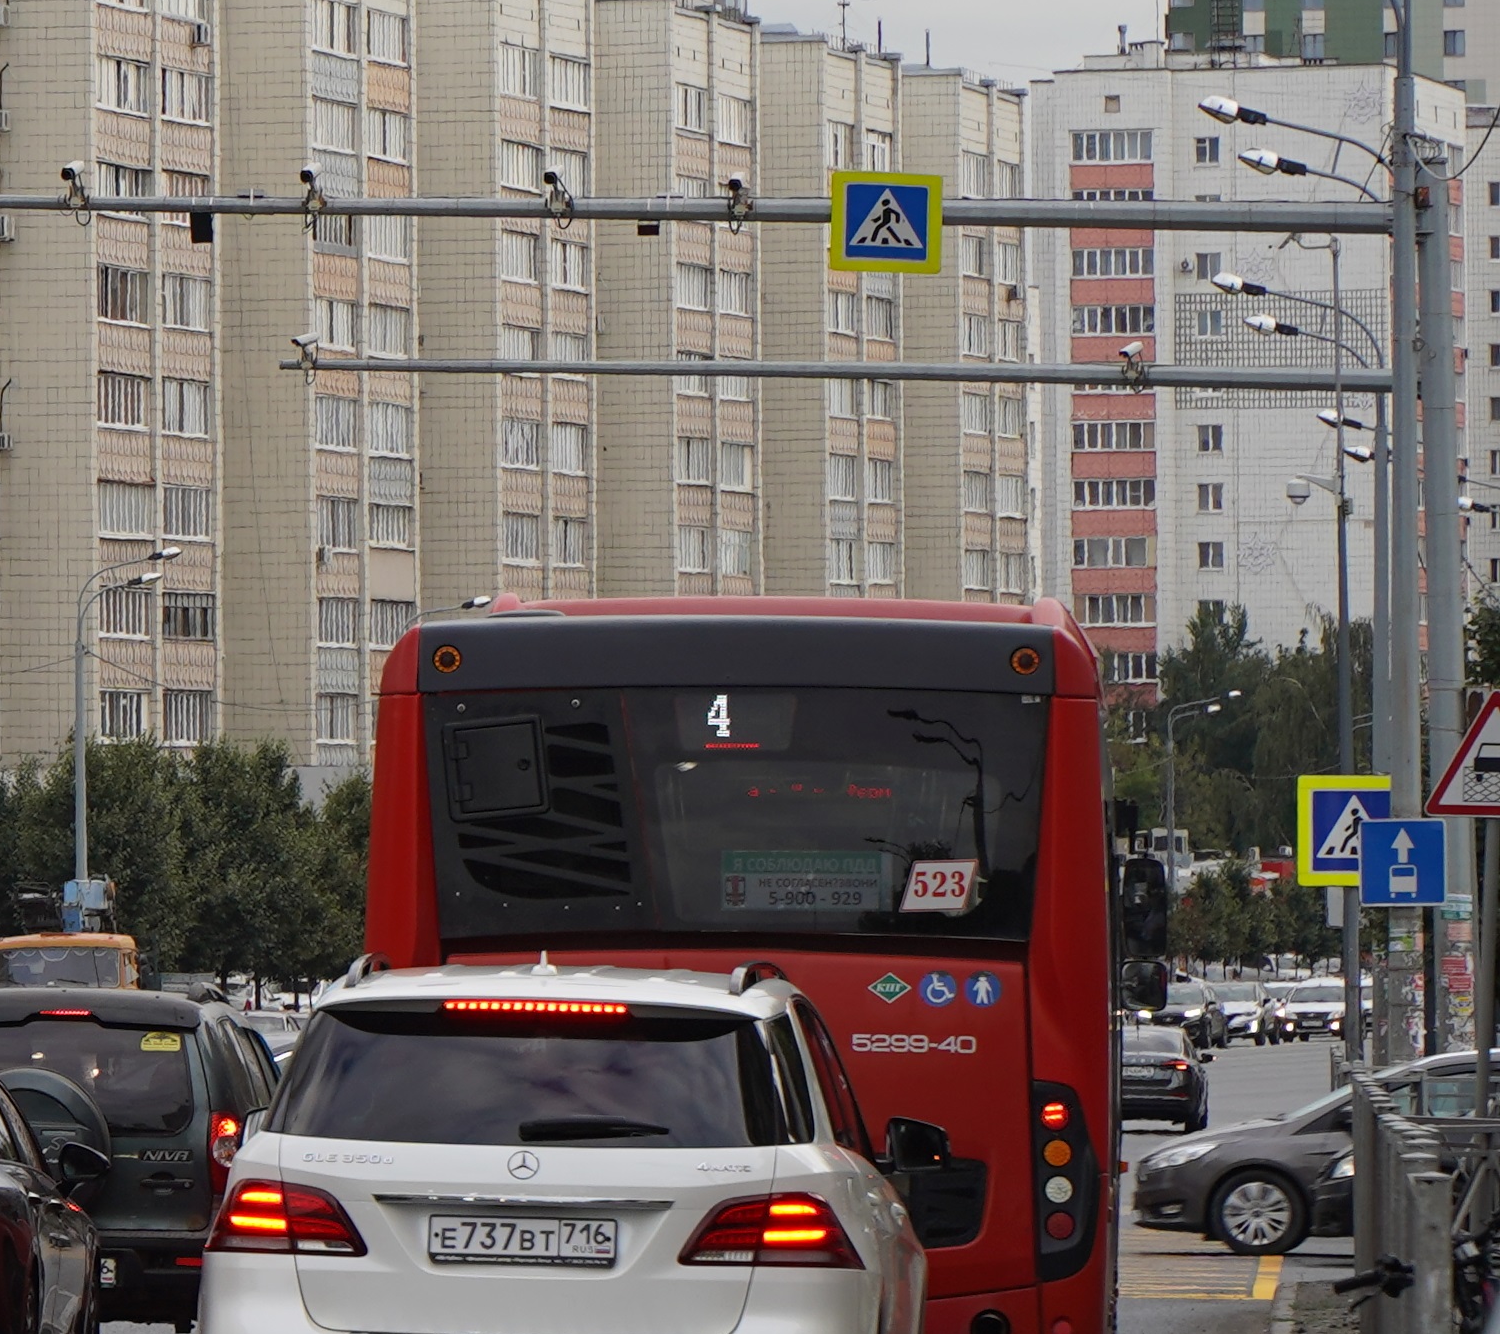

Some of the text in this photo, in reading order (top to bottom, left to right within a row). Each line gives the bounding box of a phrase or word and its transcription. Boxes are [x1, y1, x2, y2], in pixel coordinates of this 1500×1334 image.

[707, 695, 731, 738] 4
[759, 879, 773, 888] НЕ
[913, 871, 966, 898] 523
[875, 982, 903, 993] КПГ
[852, 1033, 977, 1054] 5299-40
[142, 1150, 189, 1162] NIVA
[302, 1153, 338, 1163] GLE
[563, 1223, 608, 1245] 716
[572, 1246, 594, 1254] RUS
